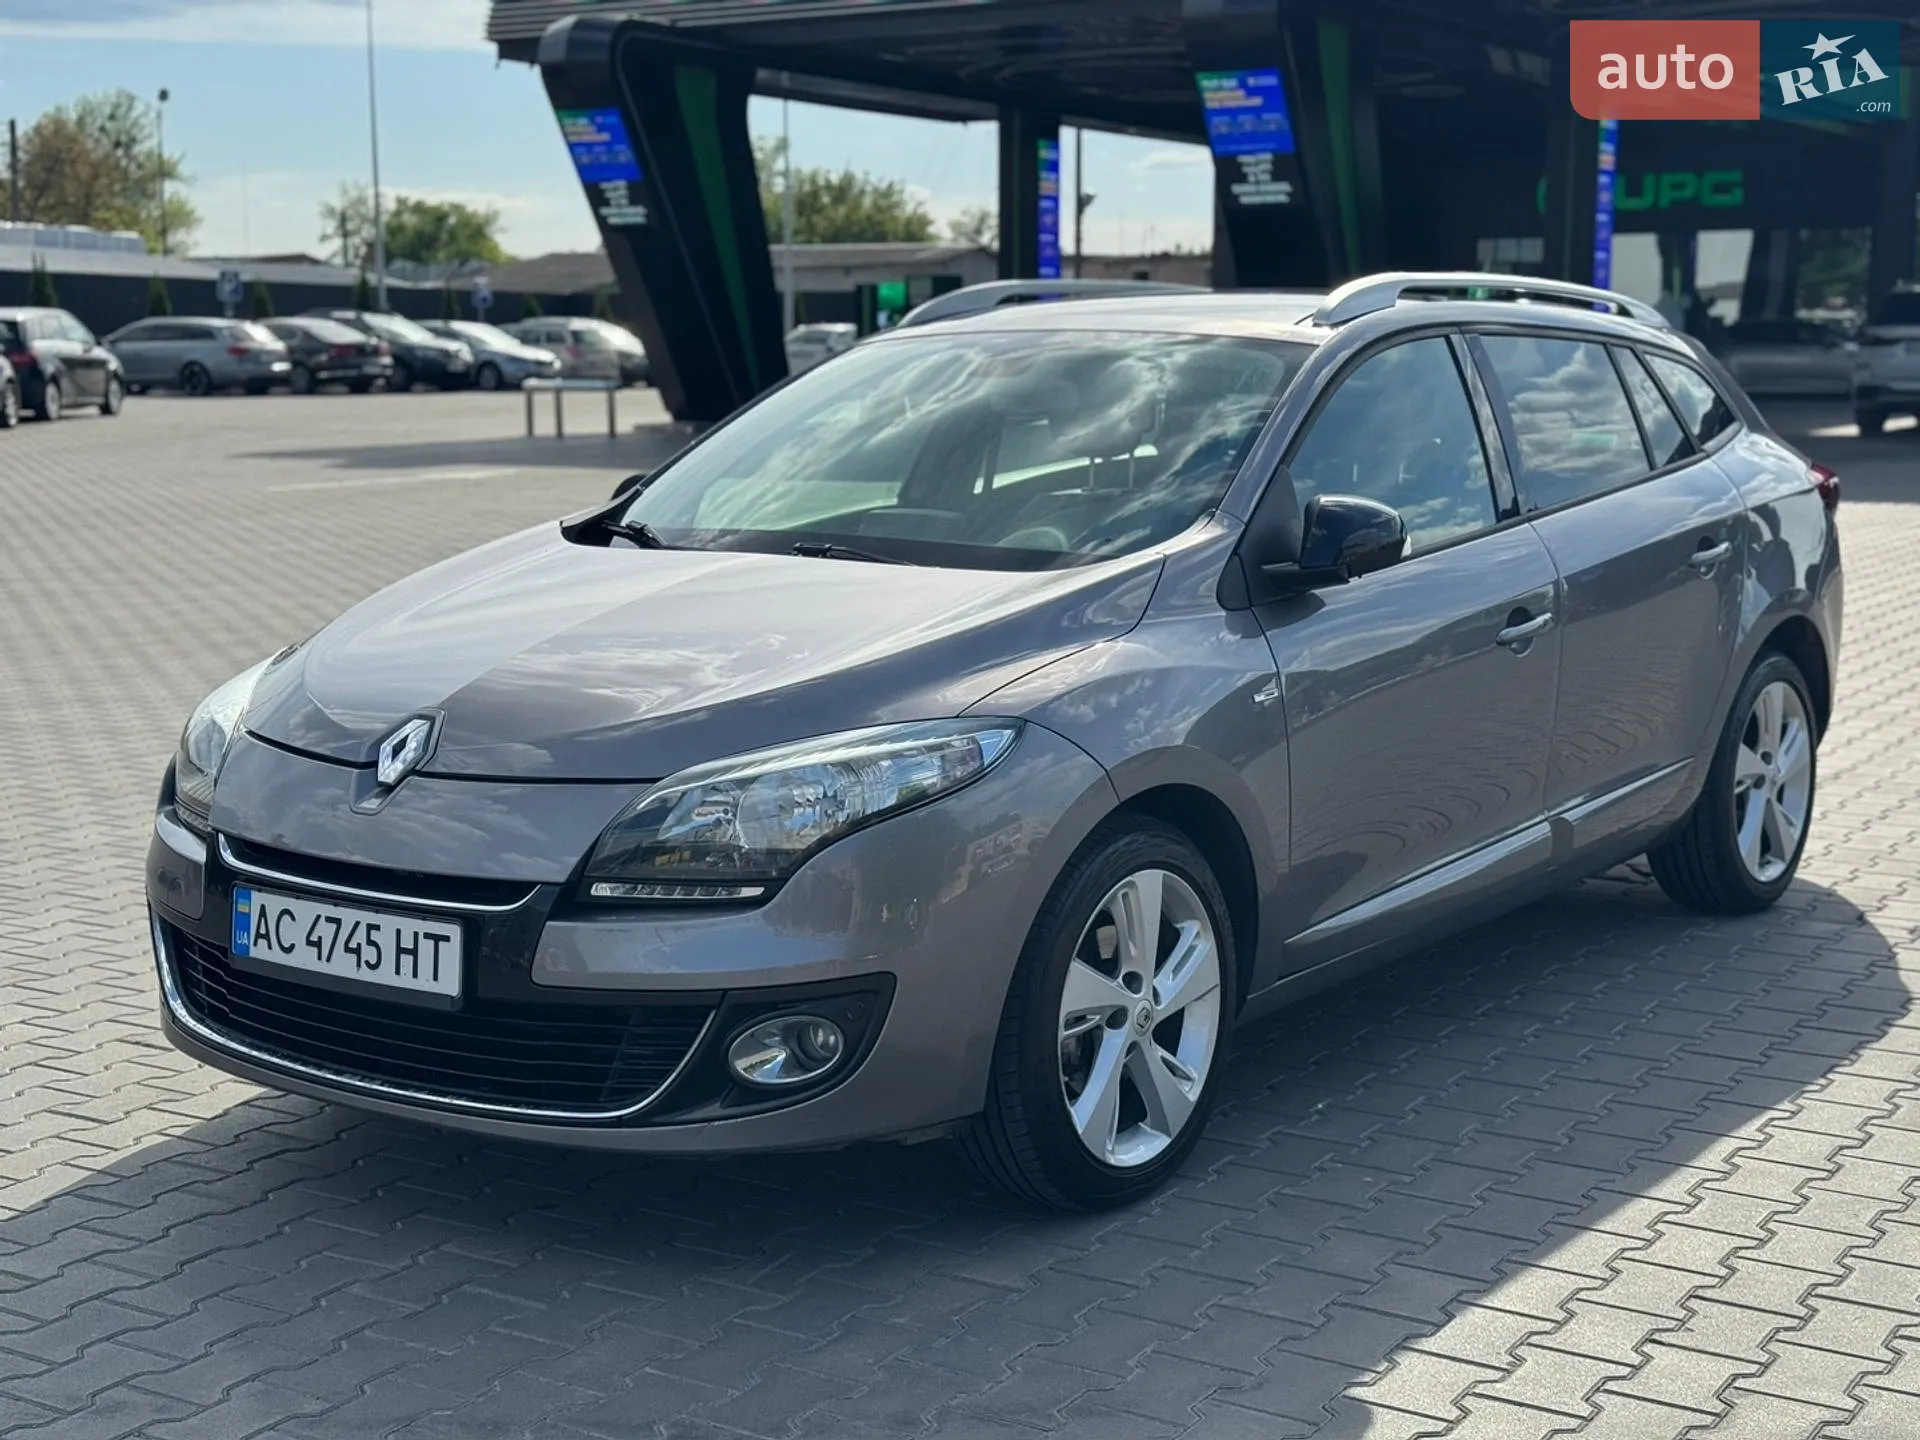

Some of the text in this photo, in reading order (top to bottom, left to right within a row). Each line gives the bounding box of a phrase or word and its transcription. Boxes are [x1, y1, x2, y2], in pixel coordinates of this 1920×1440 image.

[1614, 170, 1744, 211] UPG
[236, 929, 249, 945] UA
[253, 903, 451, 981] AC 4745 HT
